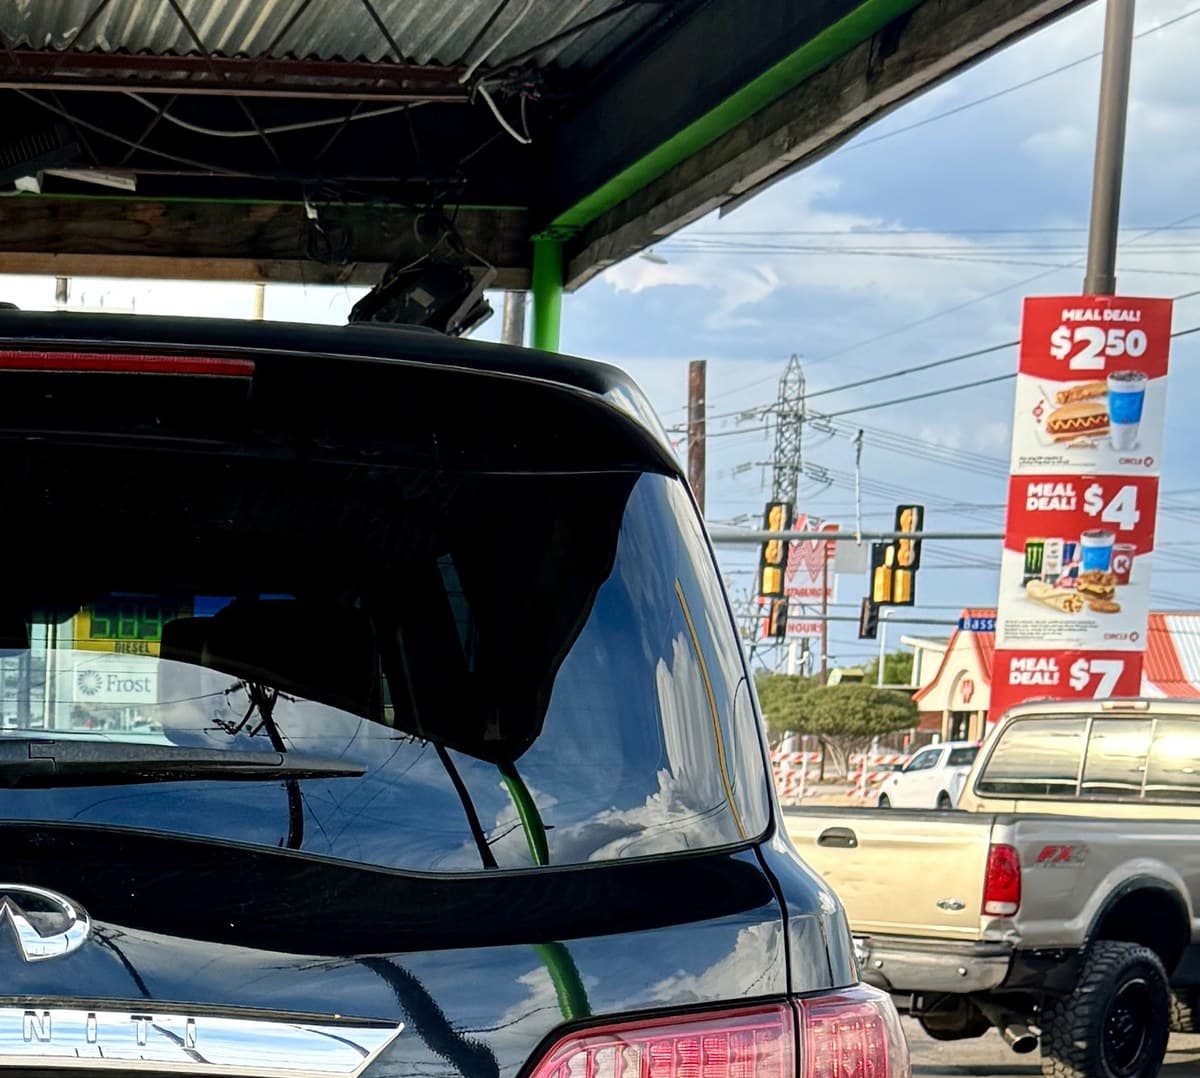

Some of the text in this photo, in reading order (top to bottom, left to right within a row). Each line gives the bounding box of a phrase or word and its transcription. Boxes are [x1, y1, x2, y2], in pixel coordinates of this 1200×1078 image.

[1061, 309, 1141, 322] MEAL DEAL!
[1027, 482, 1076, 497] MEAL
[1026, 497, 1076, 511] DEAL!
[1083, 484, 1141, 530] $4
[114, 641, 150, 654] DIESEL
[1010, 657, 1059, 671] MEAL
[106, 674, 152, 693] Frost
[1009, 671, 1059, 685] DEAL!
[1069, 658, 1125, 700] $7
